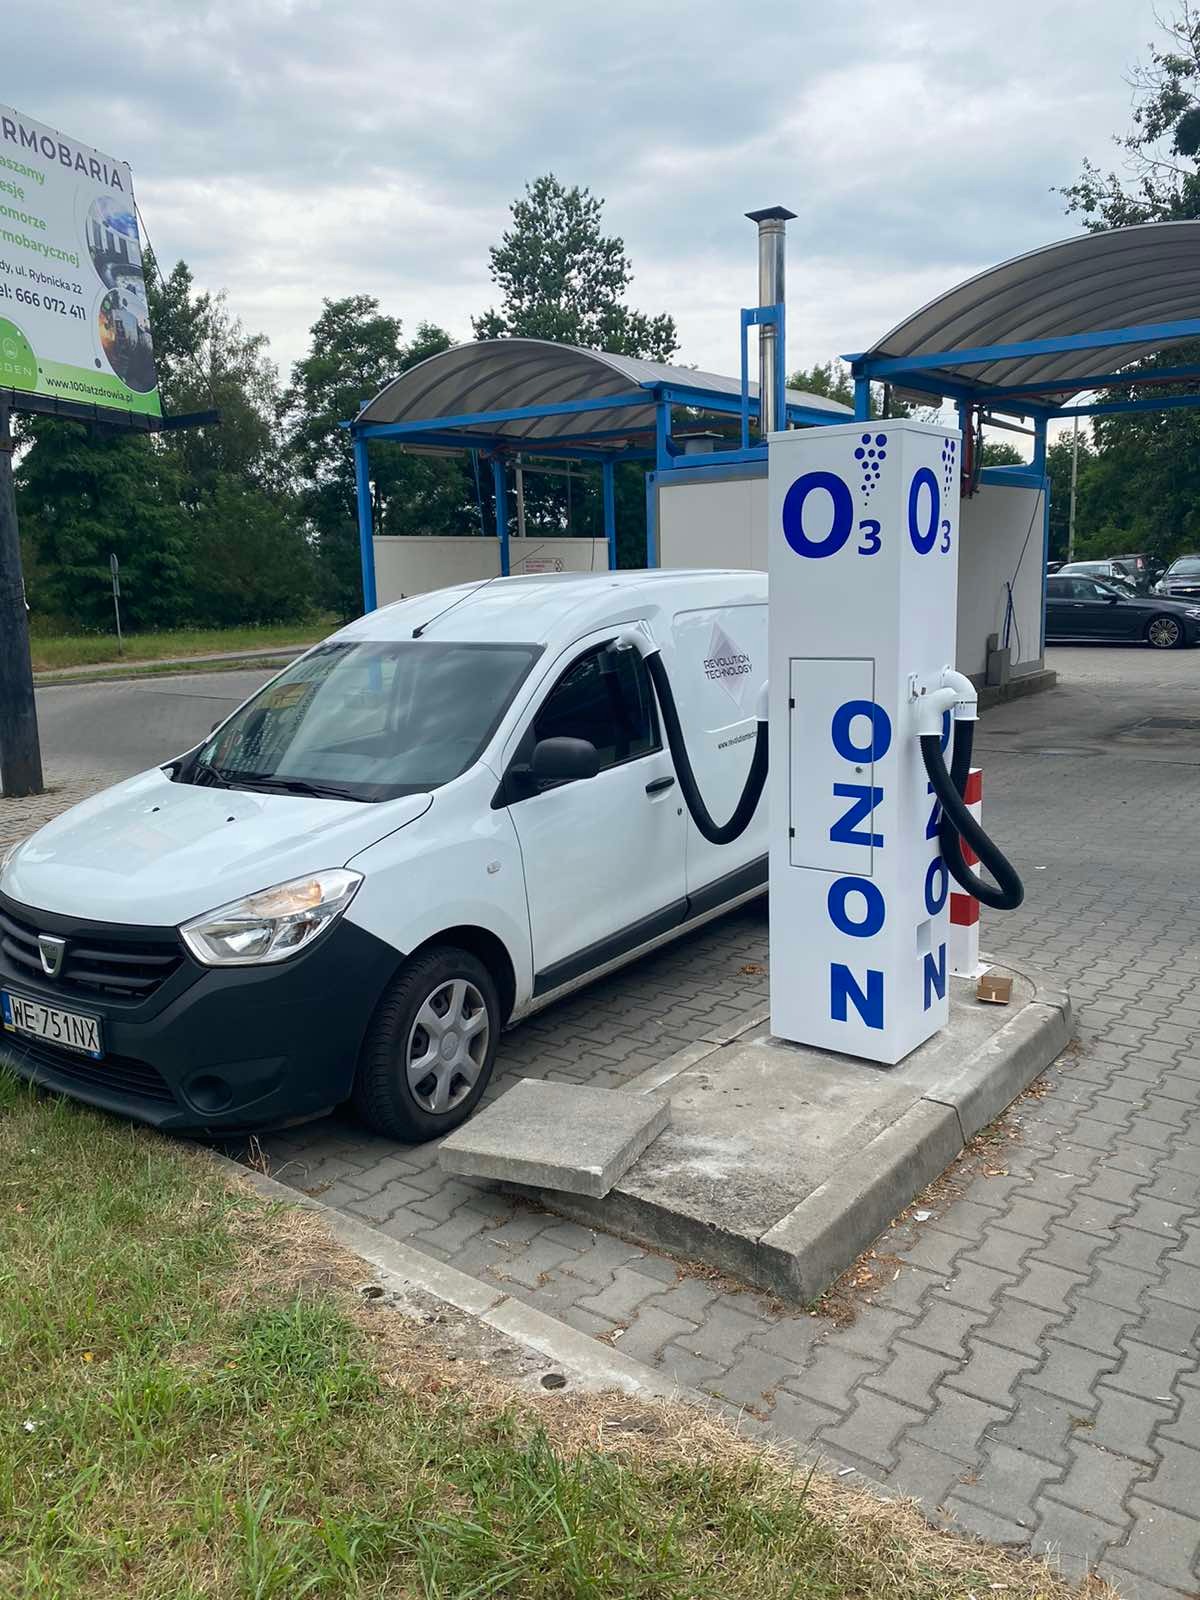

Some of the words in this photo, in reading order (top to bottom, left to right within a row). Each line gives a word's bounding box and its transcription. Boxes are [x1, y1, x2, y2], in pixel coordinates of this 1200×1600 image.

[1, 116, 124, 192] RMOBARIA
[15, 265, 27, 277] ul.
[29, 269, 71, 291] Rybnicka
[72, 283, 82, 294] 22
[16, 288, 40, 307] 666
[44, 296, 66, 315] 072
[70, 305, 86, 320] 411
[46, 378, 133, 402] www.100latzdrowia.pl
[704, 654, 750, 669] REVOLUTION
[705, 664, 752, 680] TECHNOLOGY
[828, 700, 892, 1030] OZON
[11, 998, 36, 1031] WE
[40, 1008, 98, 1049] 751NX
